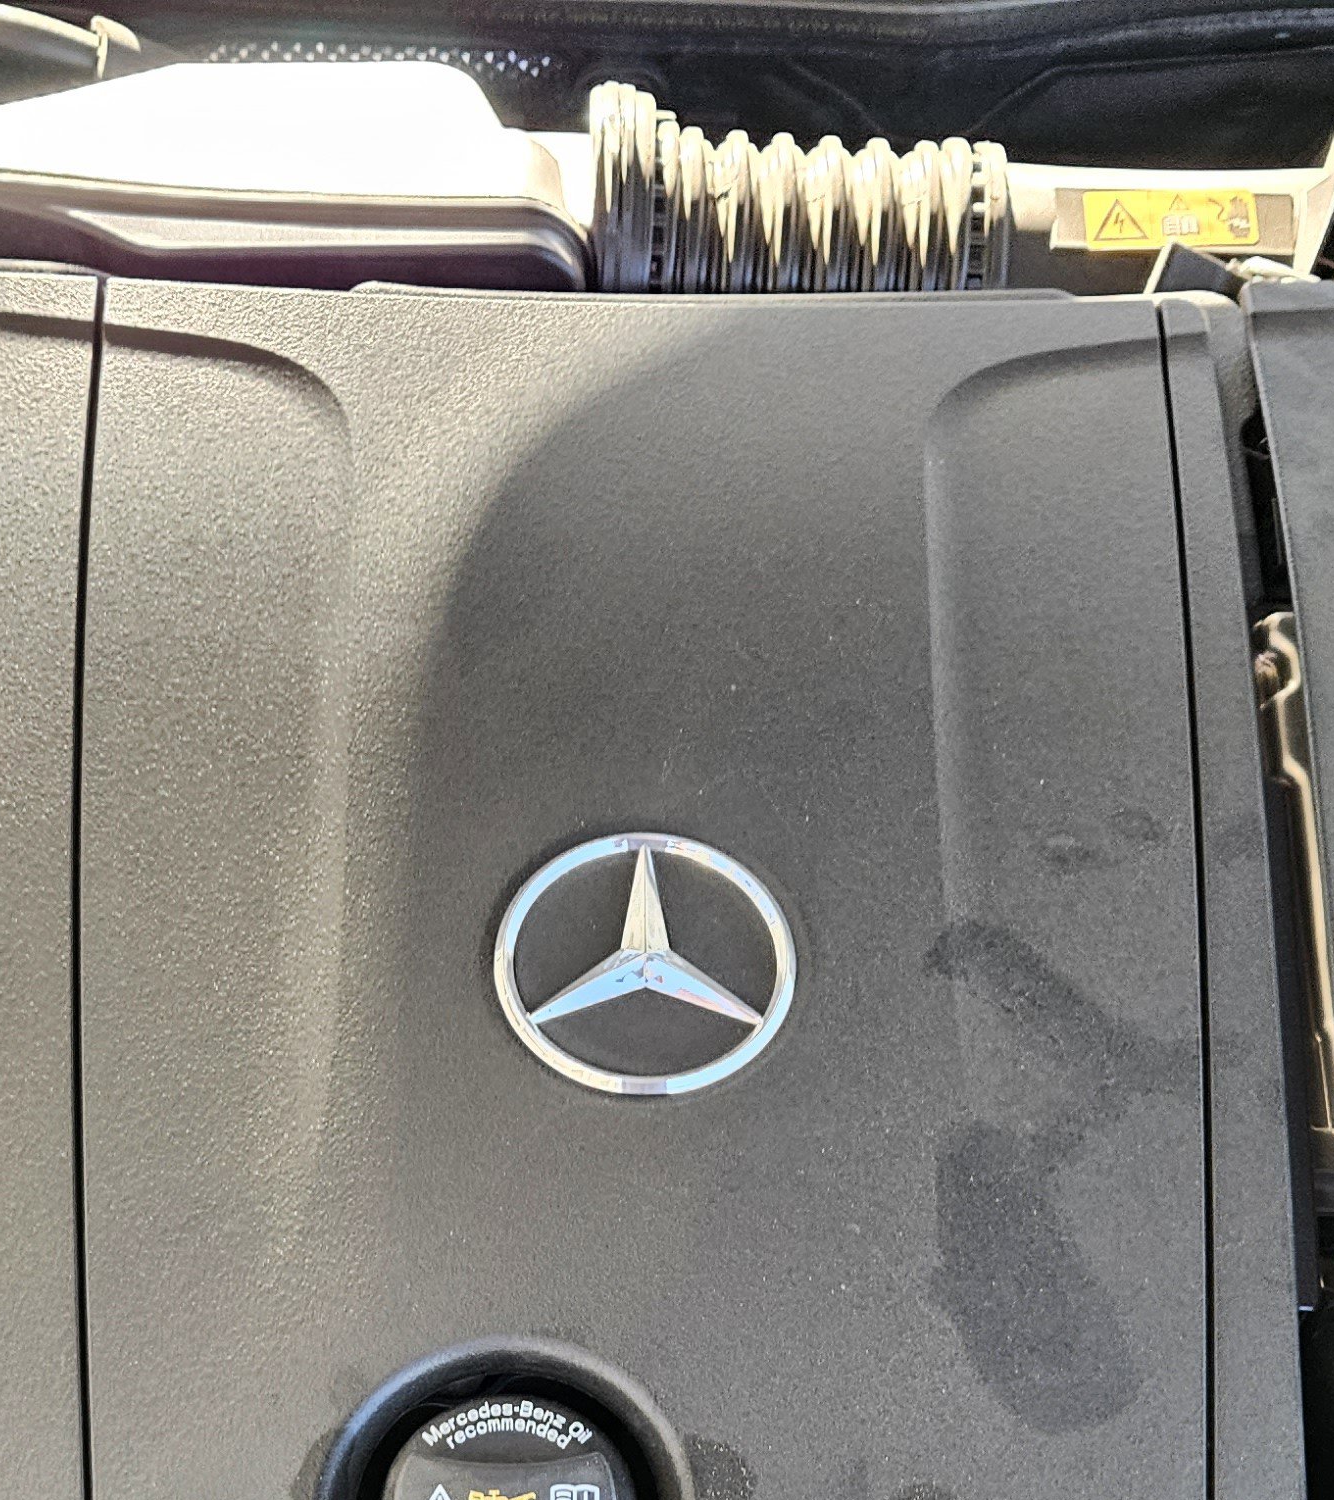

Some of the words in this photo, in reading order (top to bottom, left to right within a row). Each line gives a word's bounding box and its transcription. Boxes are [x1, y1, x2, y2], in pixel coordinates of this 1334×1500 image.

[421, 1400, 567, 1446] Mercedes-Benz
[568, 1421, 593, 1445] Oil
[446, 1415, 571, 1450] recommended
